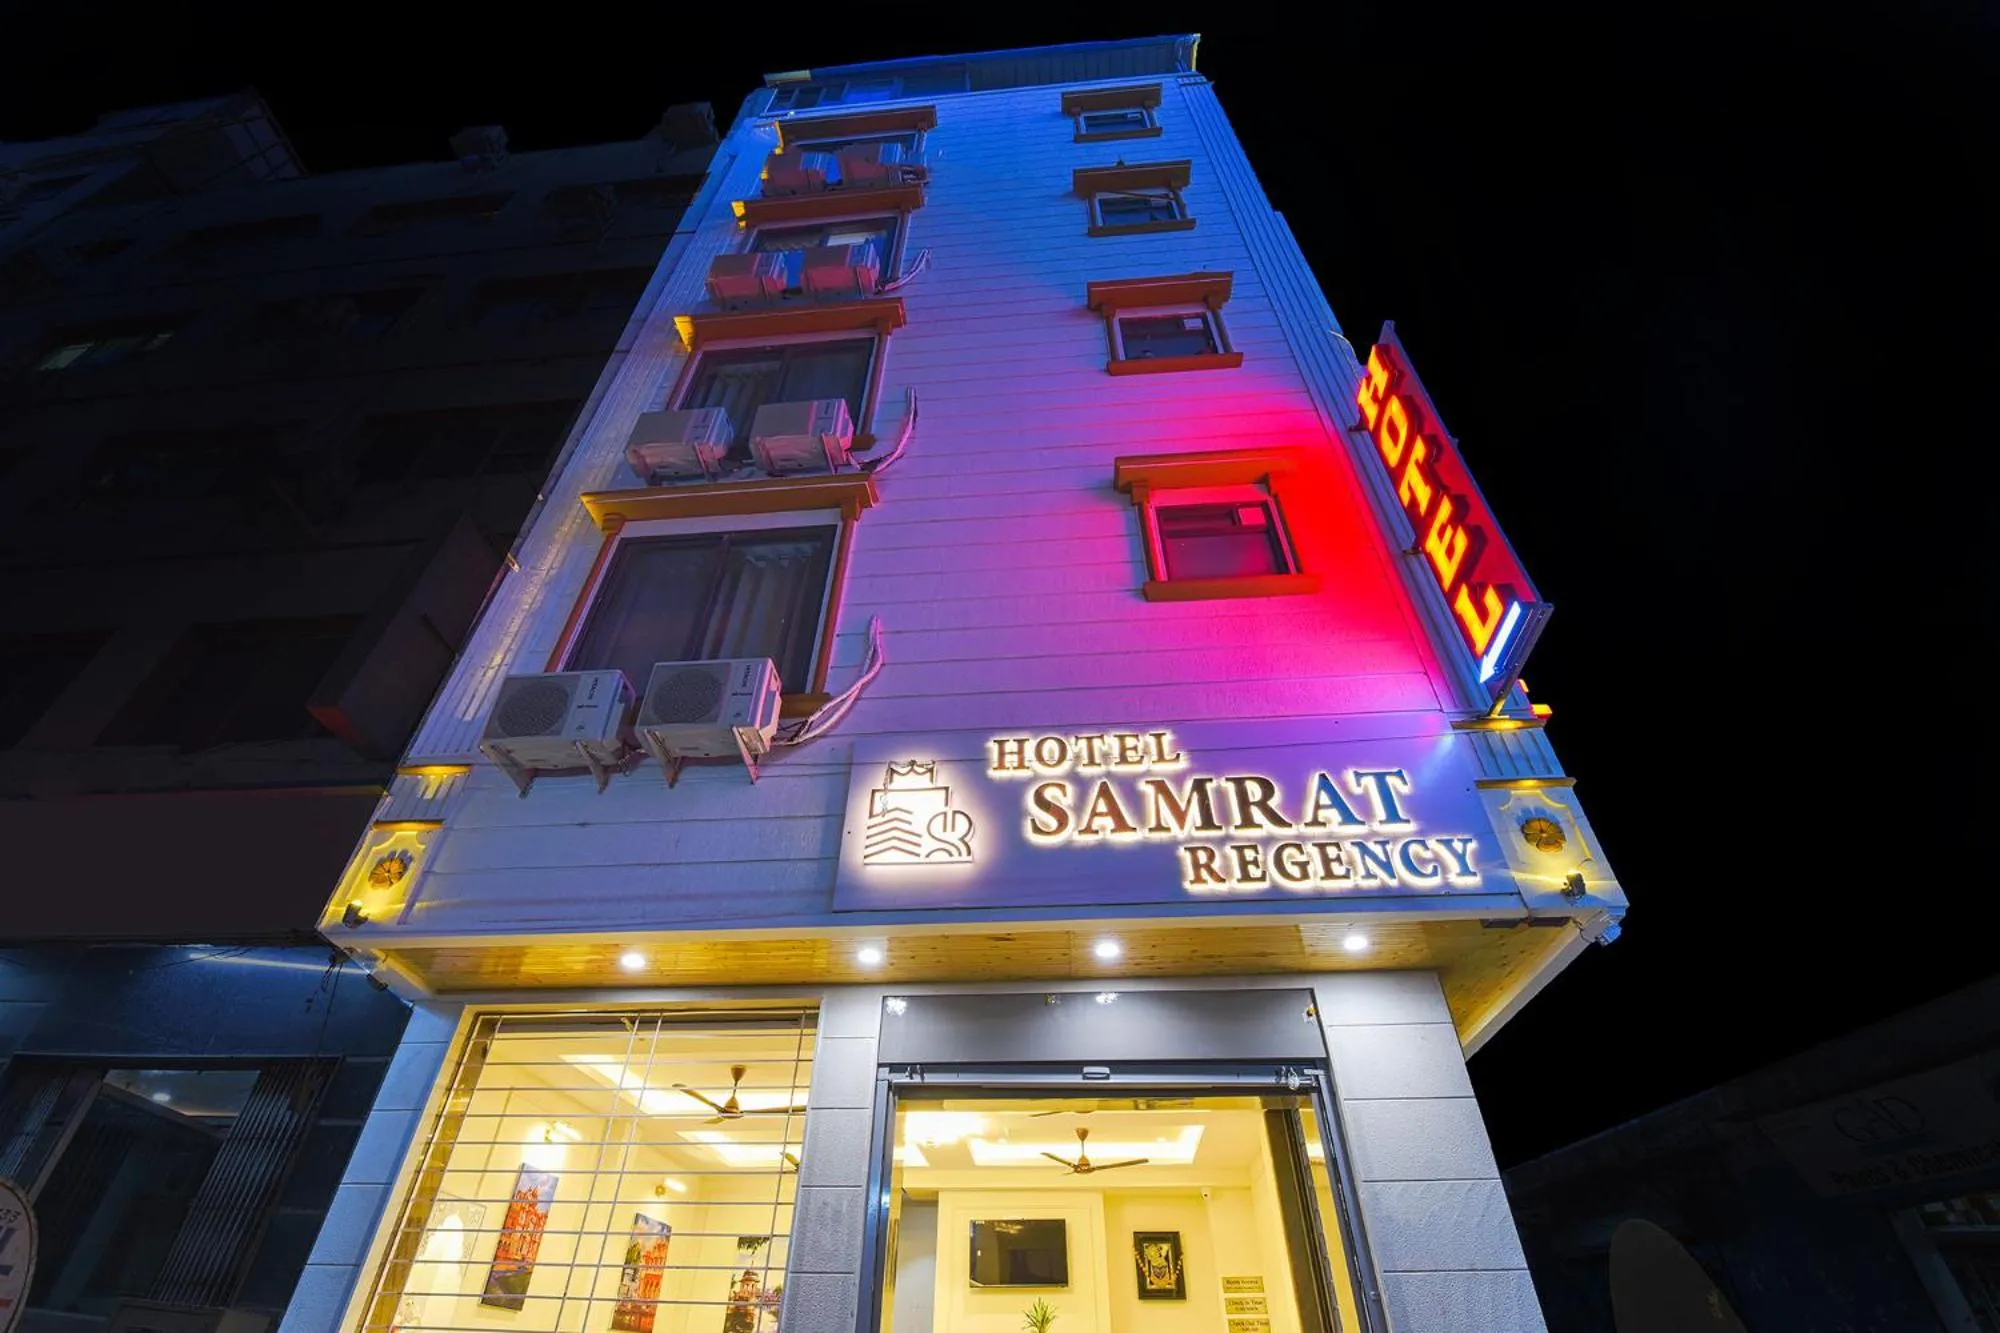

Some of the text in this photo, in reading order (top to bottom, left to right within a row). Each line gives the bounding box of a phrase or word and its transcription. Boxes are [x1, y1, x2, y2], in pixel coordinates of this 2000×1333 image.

[1356, 343, 1504, 658] HOTEL
[991, 732, 1183, 772] HOTEL
[1027, 768, 1413, 839] SAMRAT
[1183, 838, 1479, 888] REGENCY
